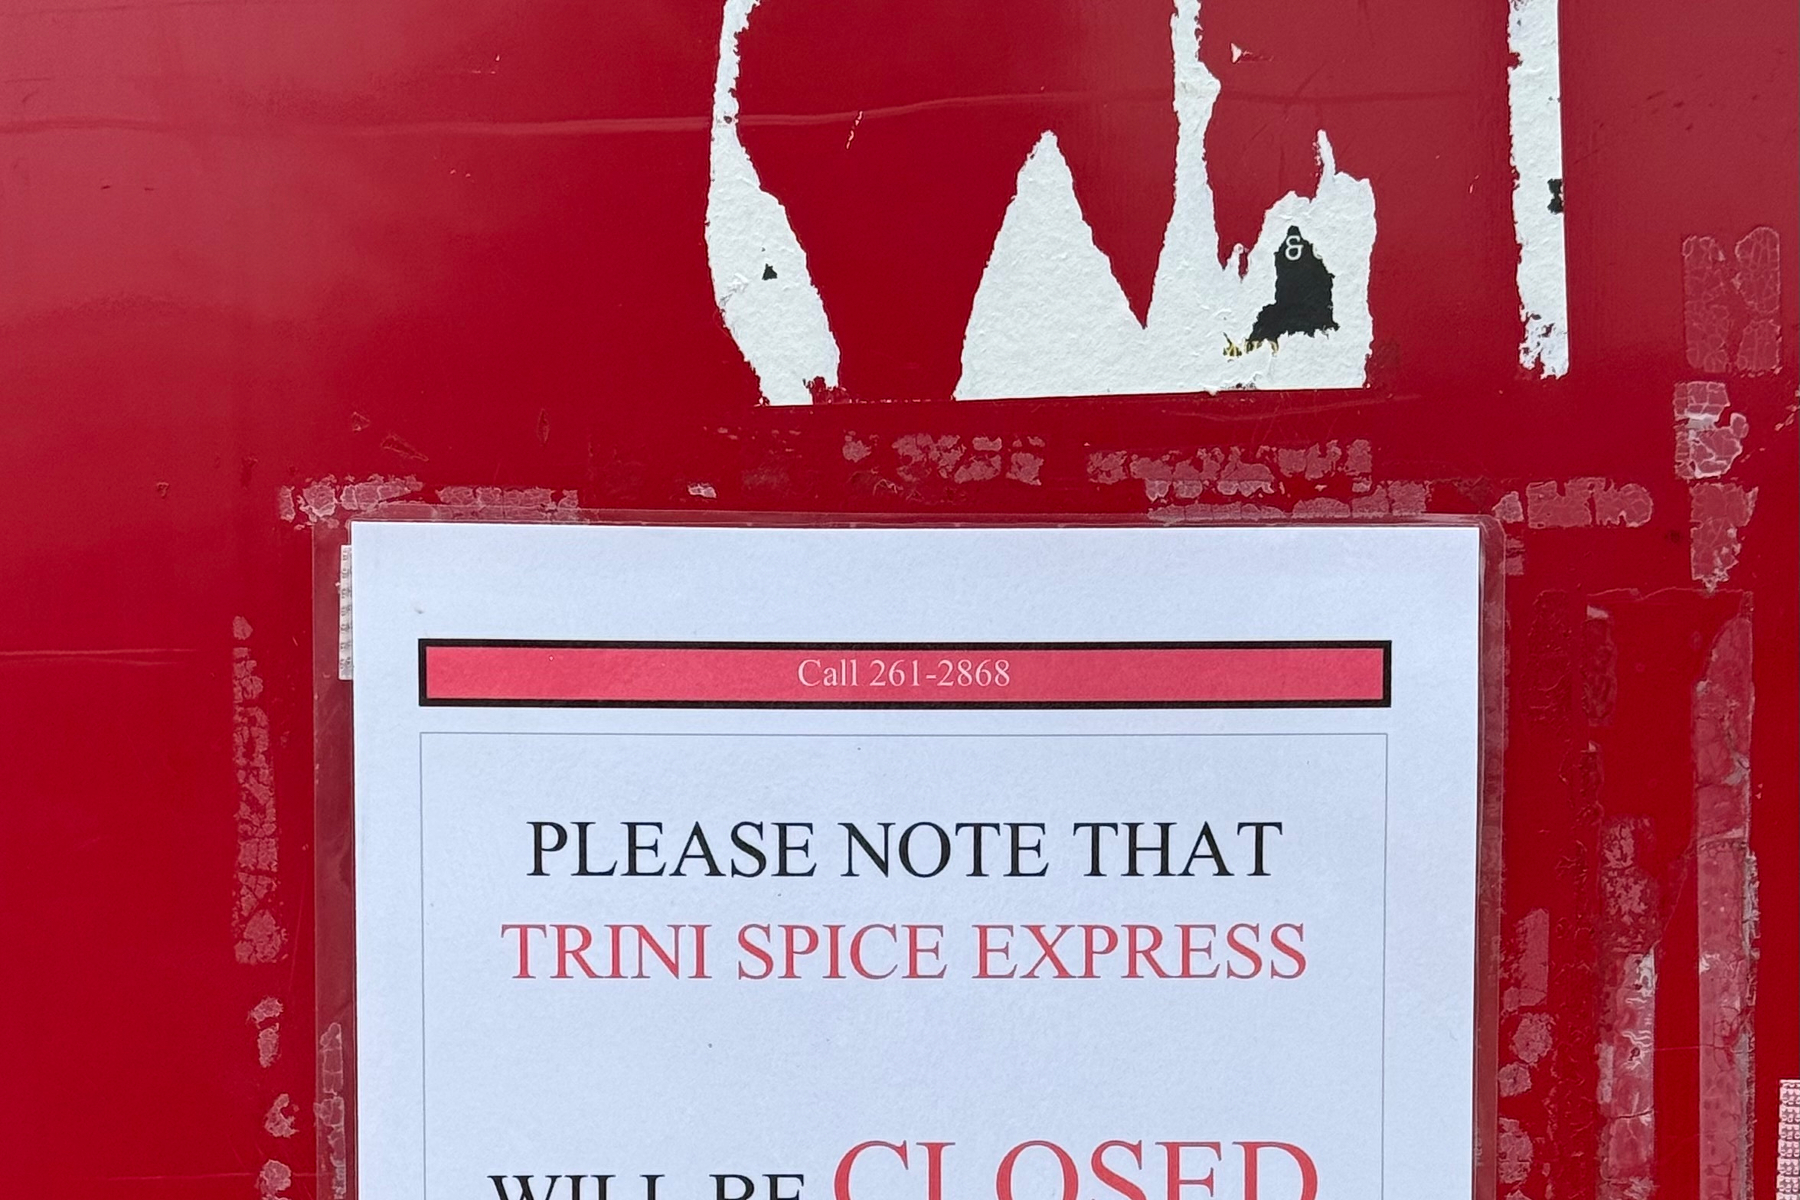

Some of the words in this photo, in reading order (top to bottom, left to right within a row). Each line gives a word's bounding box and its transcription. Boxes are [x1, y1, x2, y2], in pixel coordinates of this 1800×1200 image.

[797, 658, 859, 687] Call
[869, 659, 1011, 688] 261-2868
[527, 821, 817, 878] PLEASE
[838, 822, 1049, 878] NOTE
[1073, 821, 1282, 877] THAT
[502, 924, 712, 979] TRINI
[738, 924, 946, 979] SPICE
[972, 924, 1306, 979] EXPRESS
